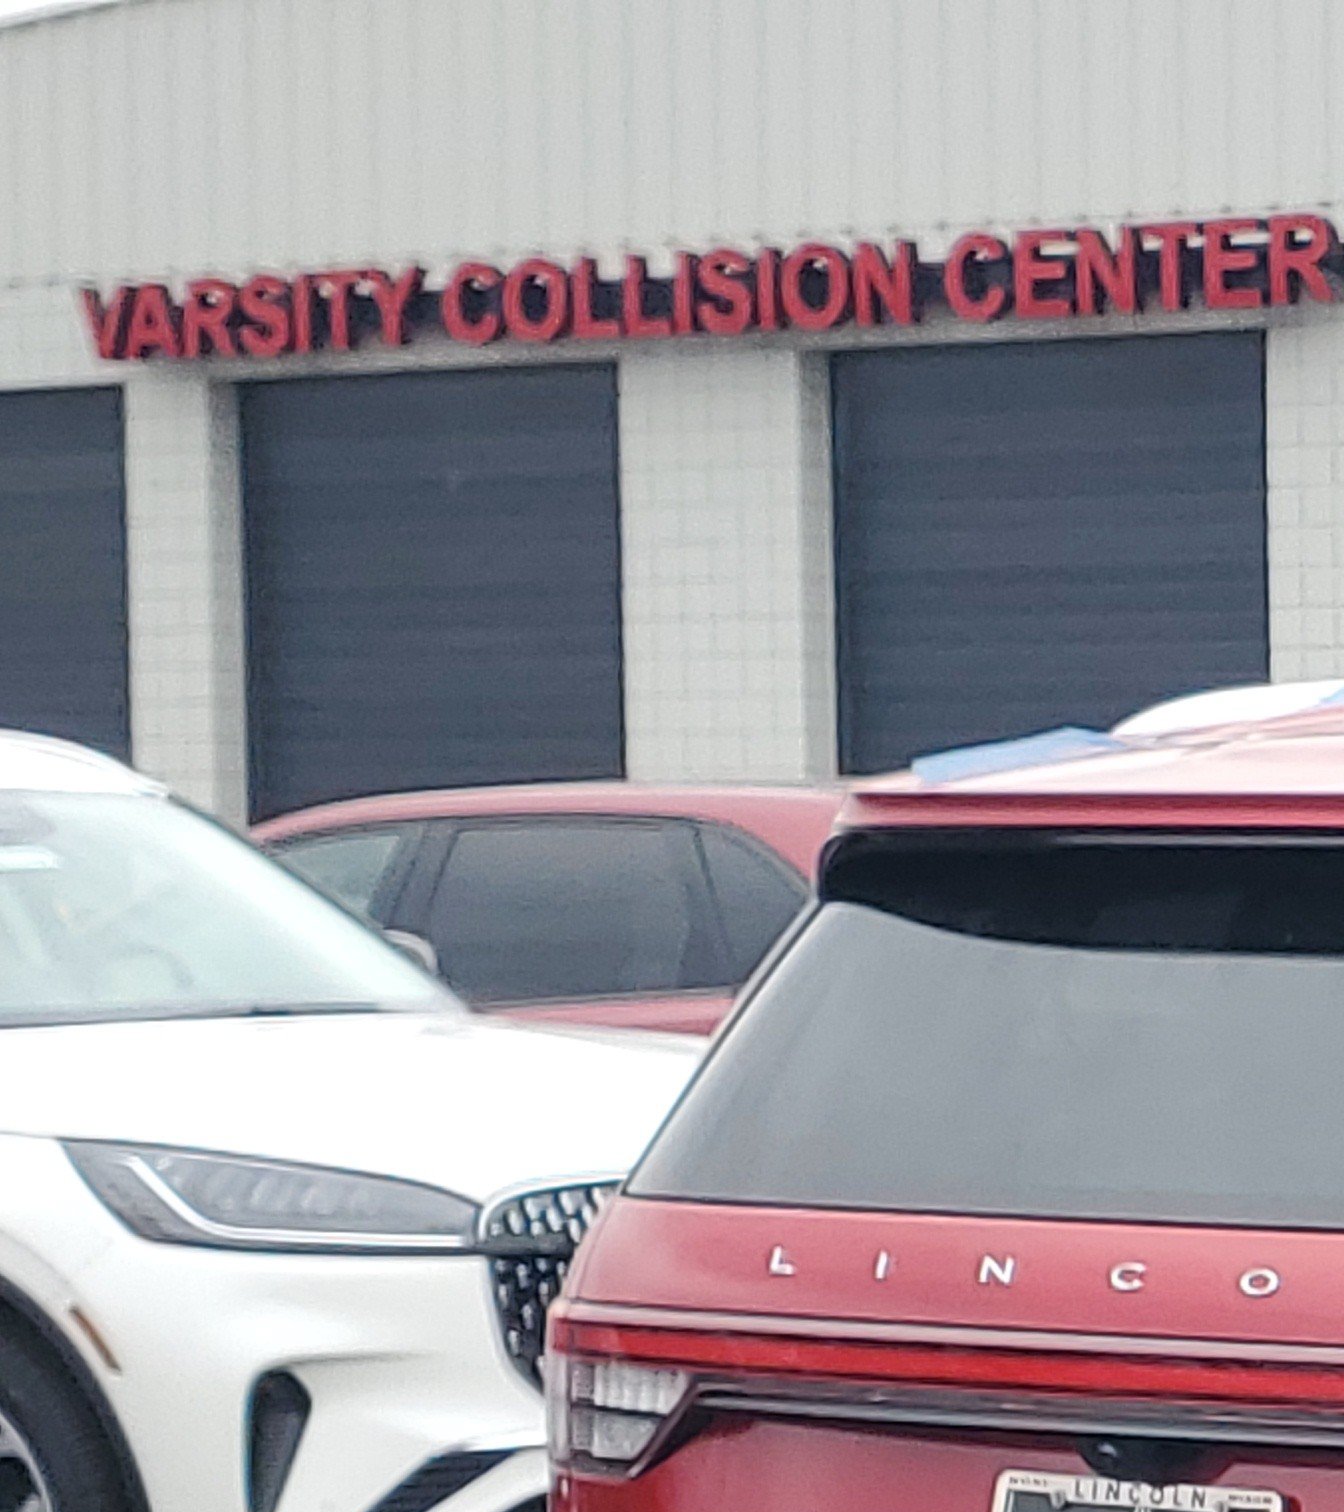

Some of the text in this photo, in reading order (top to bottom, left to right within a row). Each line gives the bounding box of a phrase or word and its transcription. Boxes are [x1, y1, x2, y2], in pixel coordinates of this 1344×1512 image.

[81, 213, 1340, 360] VARSITY COLLISION CENTER
[1075, 1478, 1206, 1508] LINCOLN
